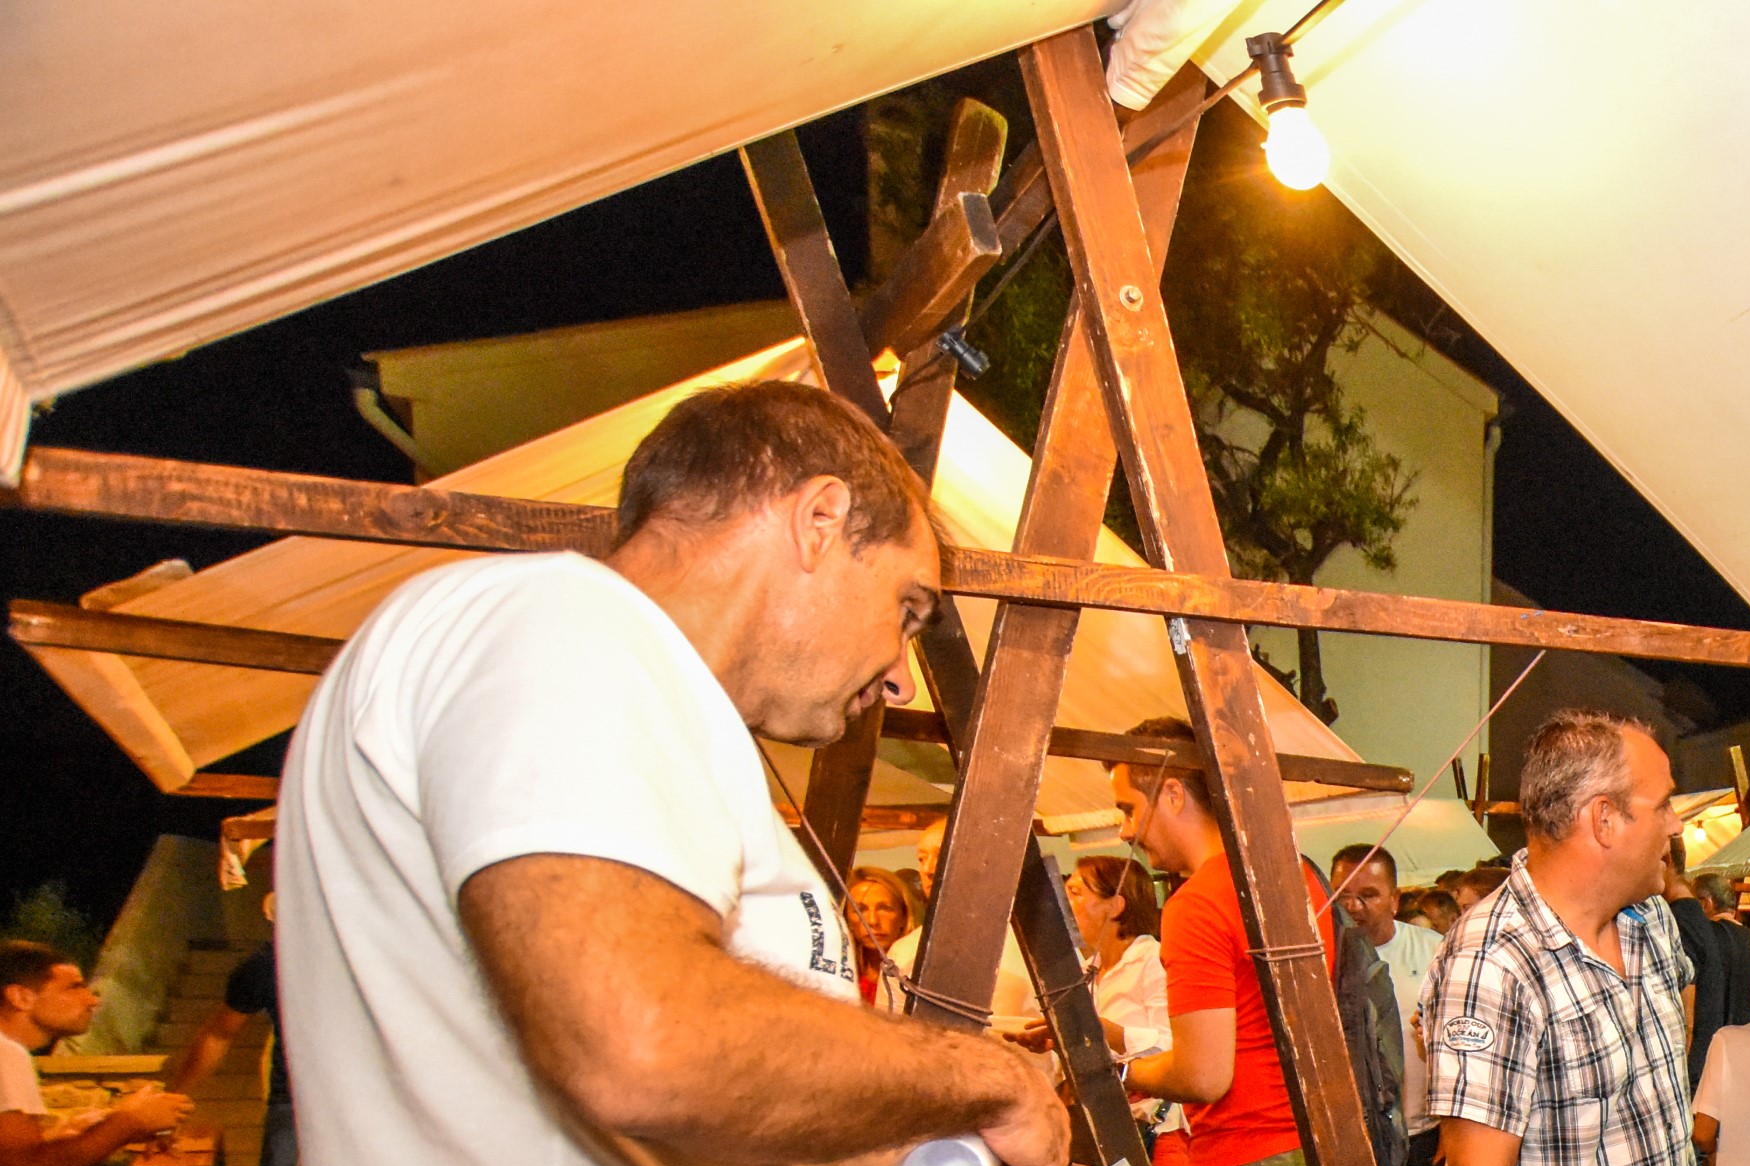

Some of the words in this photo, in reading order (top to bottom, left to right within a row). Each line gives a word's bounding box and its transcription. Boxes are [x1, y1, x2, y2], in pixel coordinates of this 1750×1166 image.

[1449, 1019, 1470, 1027] WORLD
[1471, 1021, 1487, 1029] CUP
[1452, 1030, 1480, 1038] OCEAN
